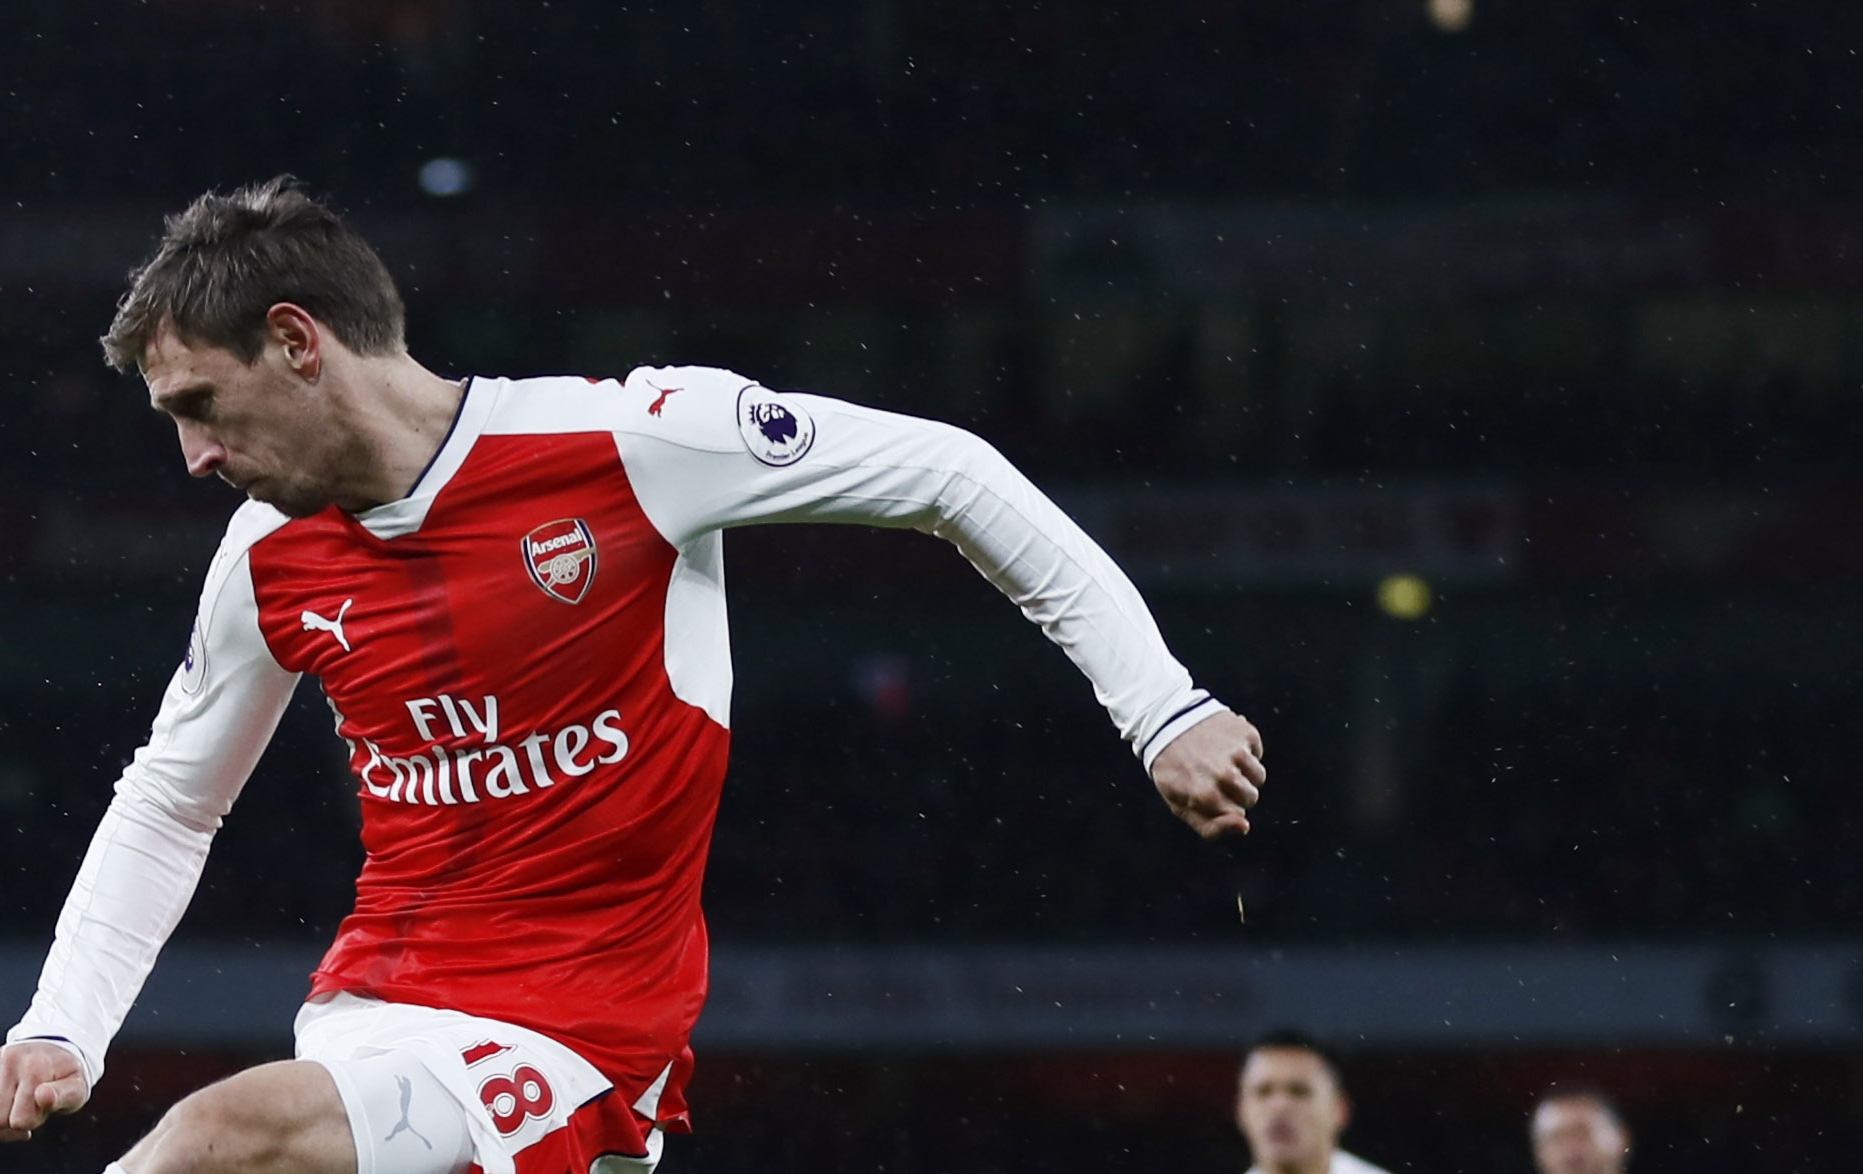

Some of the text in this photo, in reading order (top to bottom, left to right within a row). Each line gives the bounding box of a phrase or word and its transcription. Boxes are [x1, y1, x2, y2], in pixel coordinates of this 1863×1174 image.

[531, 527, 584, 558] Arsenal
[404, 694, 498, 743] Fly
[361, 709, 630, 805] Emirates
[460, 1038, 556, 1138] 18
